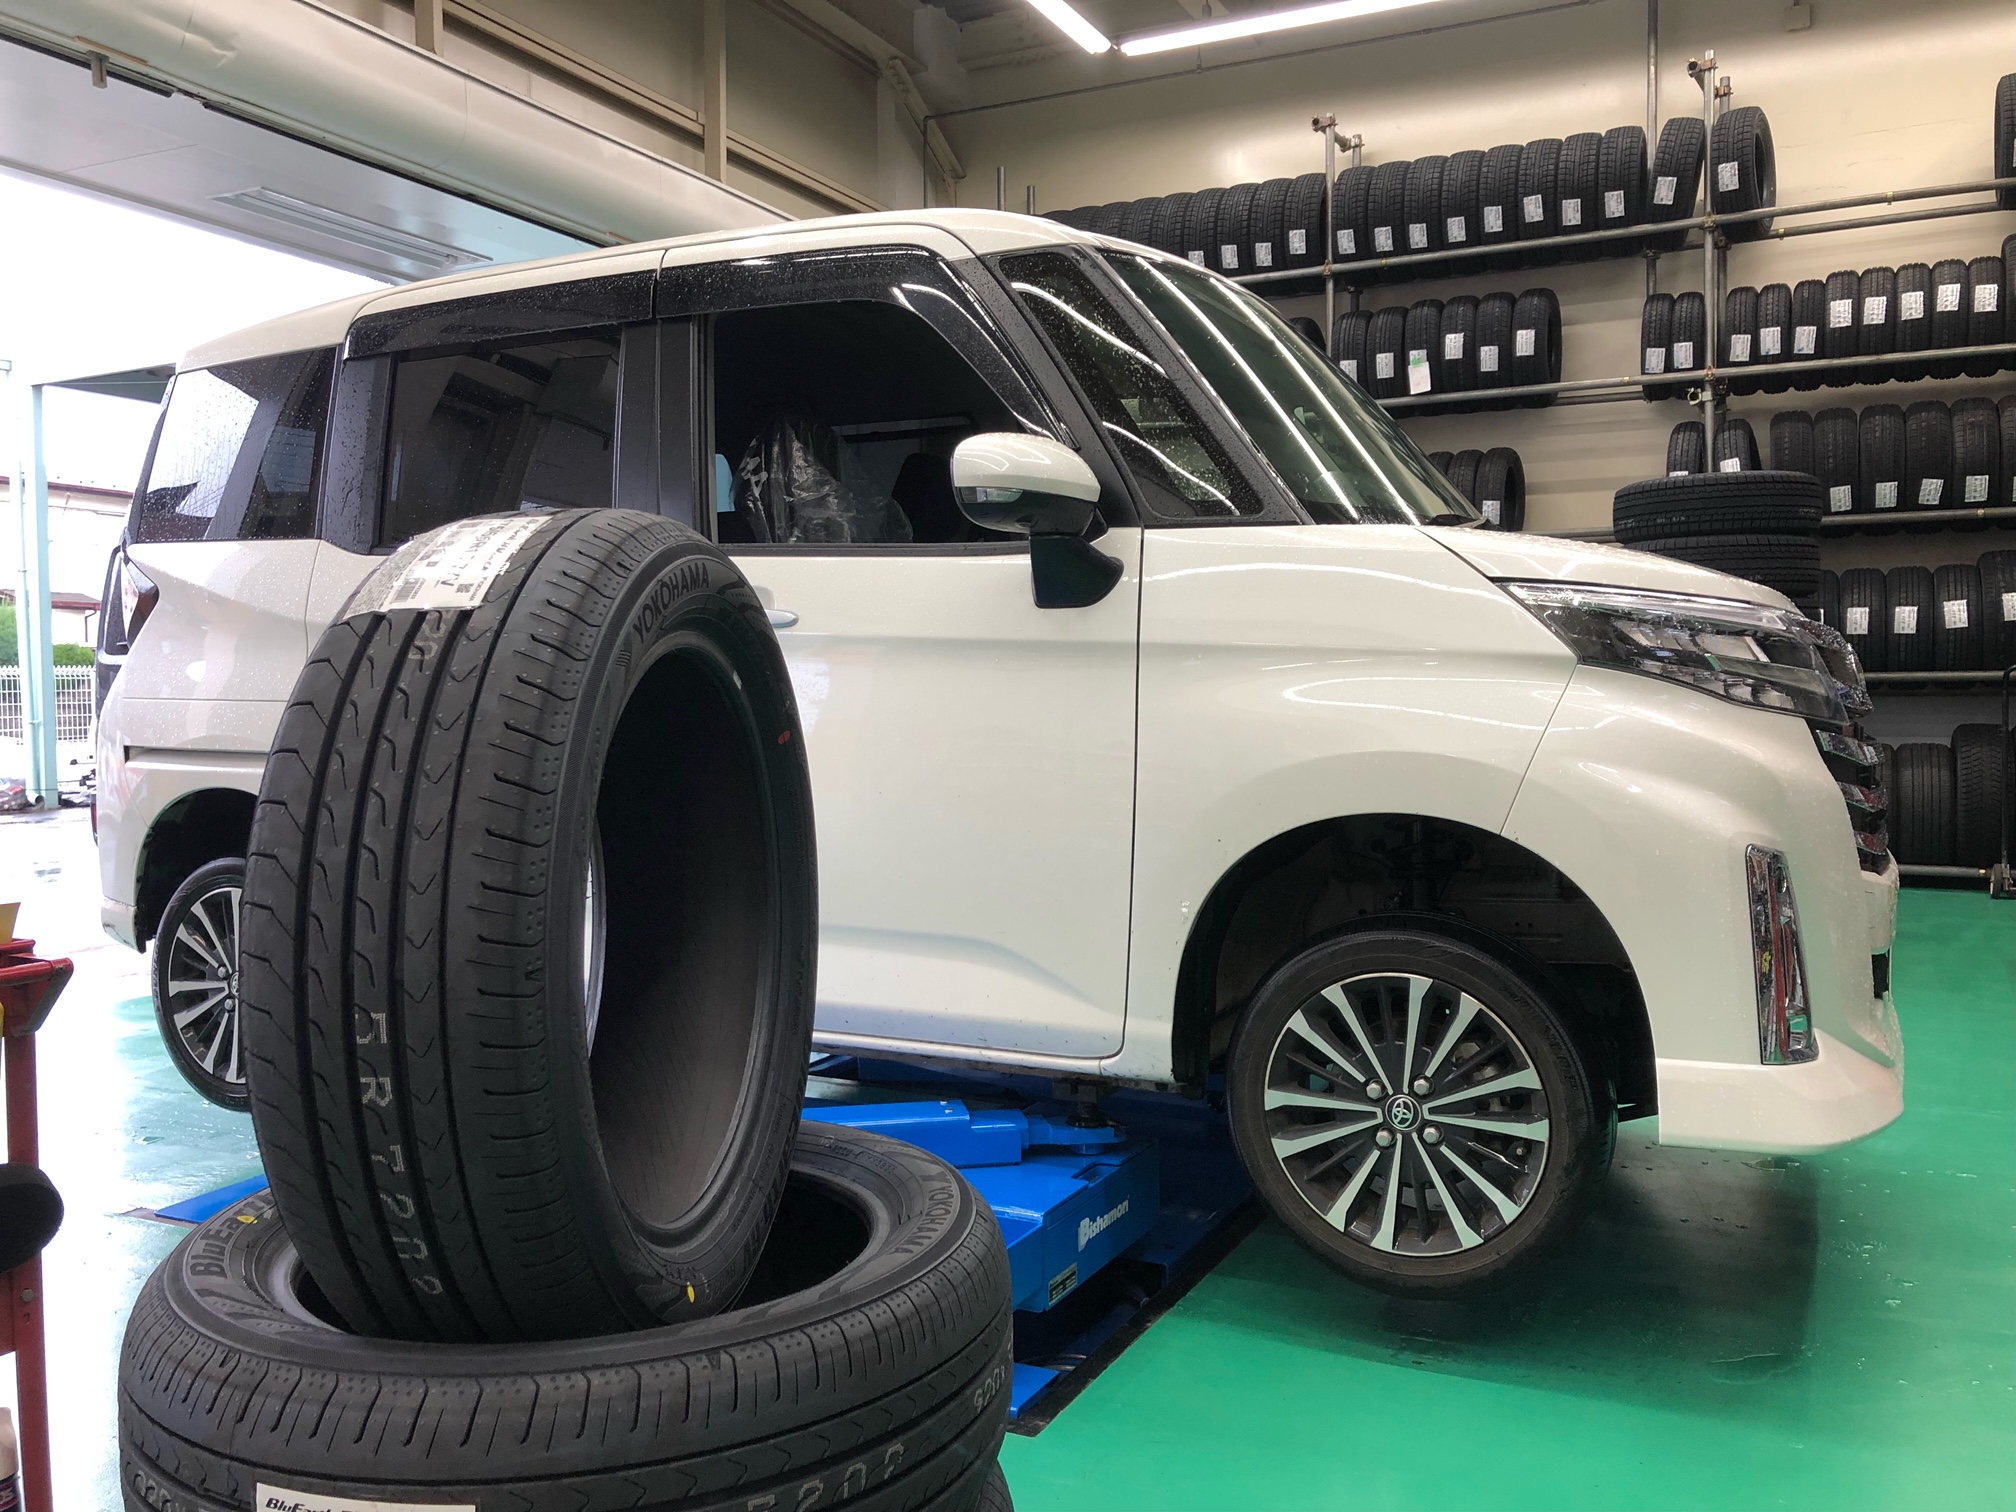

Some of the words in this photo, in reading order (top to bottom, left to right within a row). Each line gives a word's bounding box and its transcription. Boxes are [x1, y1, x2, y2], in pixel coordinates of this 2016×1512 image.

[633, 563, 709, 644] YOKOHAMA
[892, 1184, 955, 1255] YOKOHAMA
[1078, 1199, 1130, 1253] Bishamon
